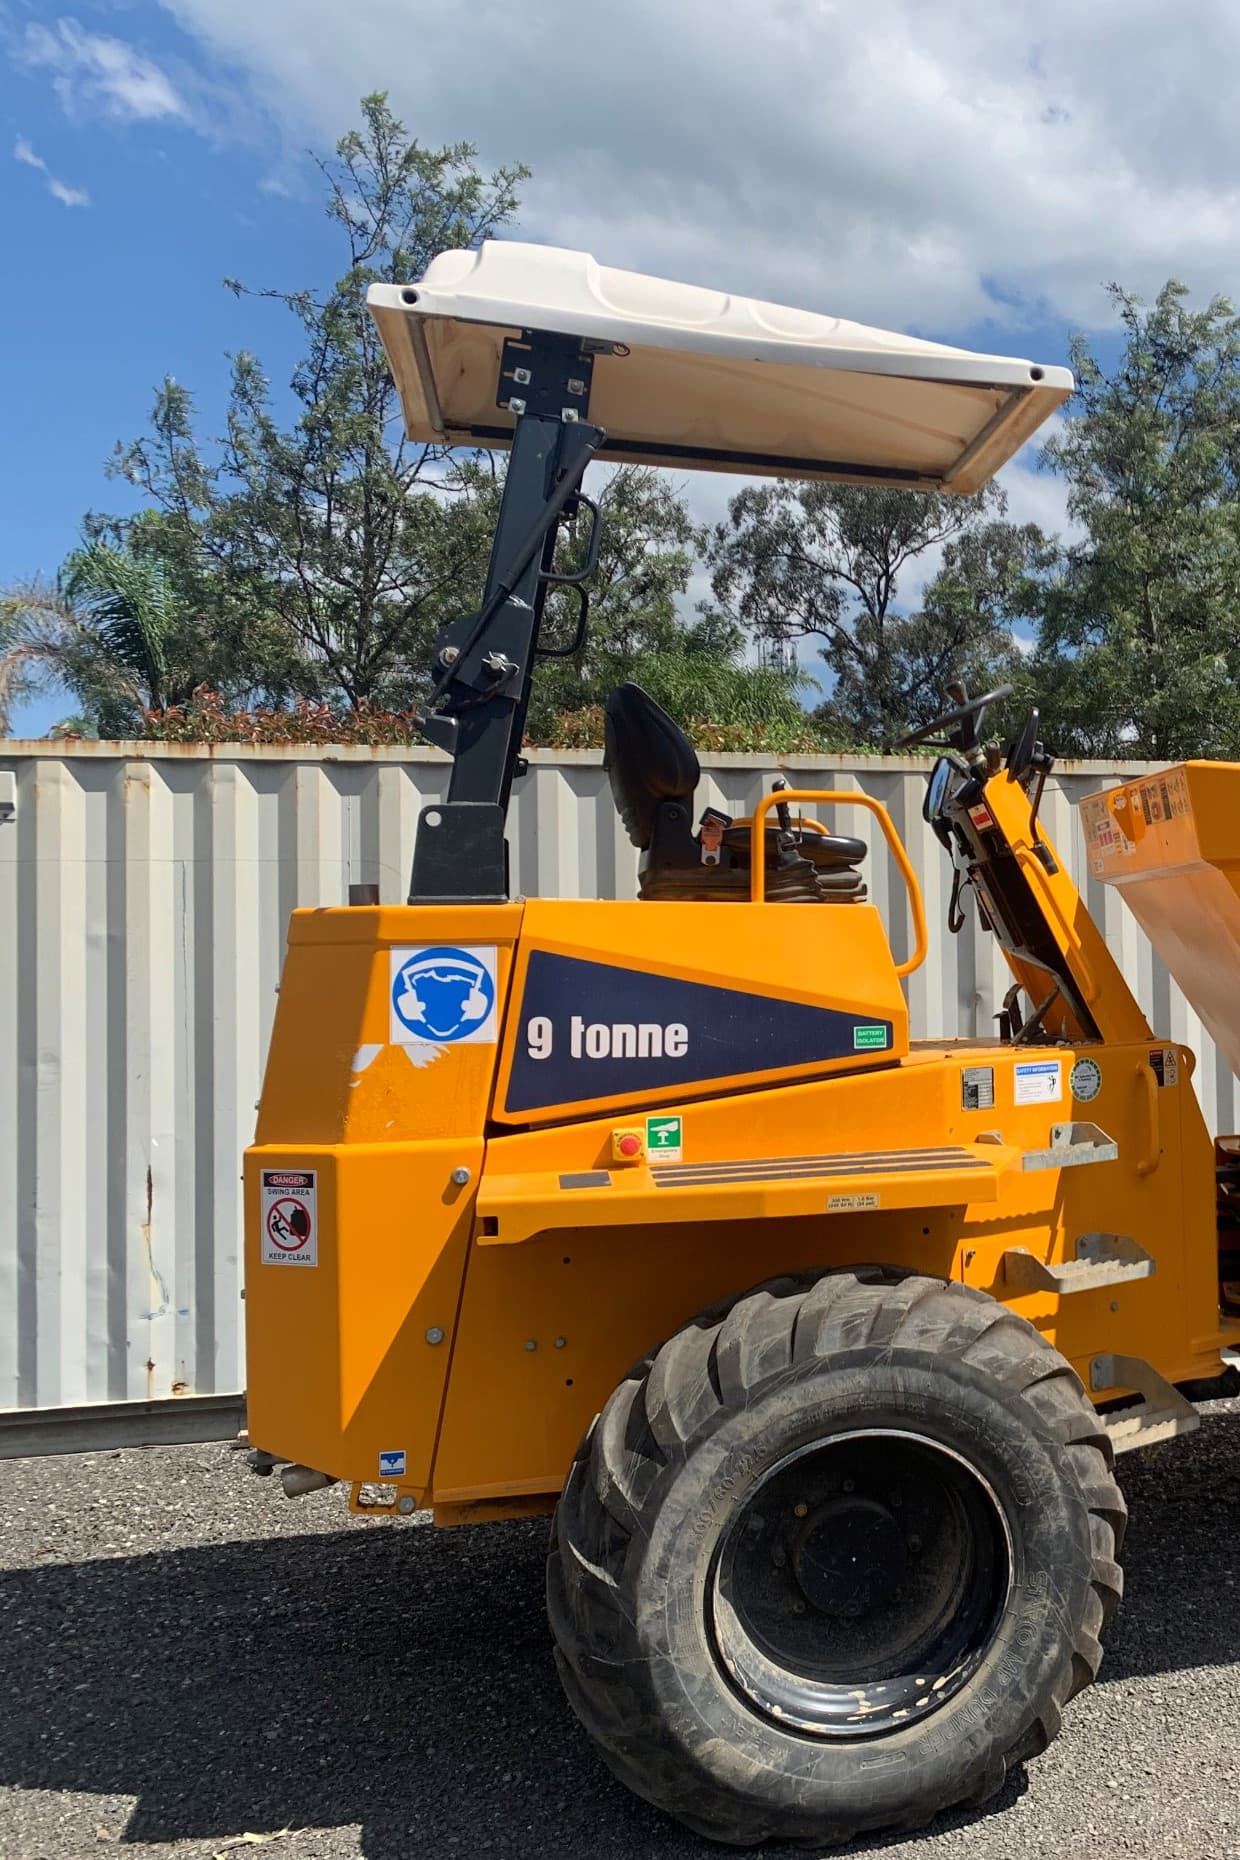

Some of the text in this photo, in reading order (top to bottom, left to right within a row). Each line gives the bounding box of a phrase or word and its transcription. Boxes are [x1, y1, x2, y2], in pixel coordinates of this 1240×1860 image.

[527, 1015, 689, 1060] 9 tonne
[272, 1175, 305, 1185] DANGER
[291, 1188, 310, 1196] AREA
[268, 1252, 311, 1261] KEEP CLEAR
